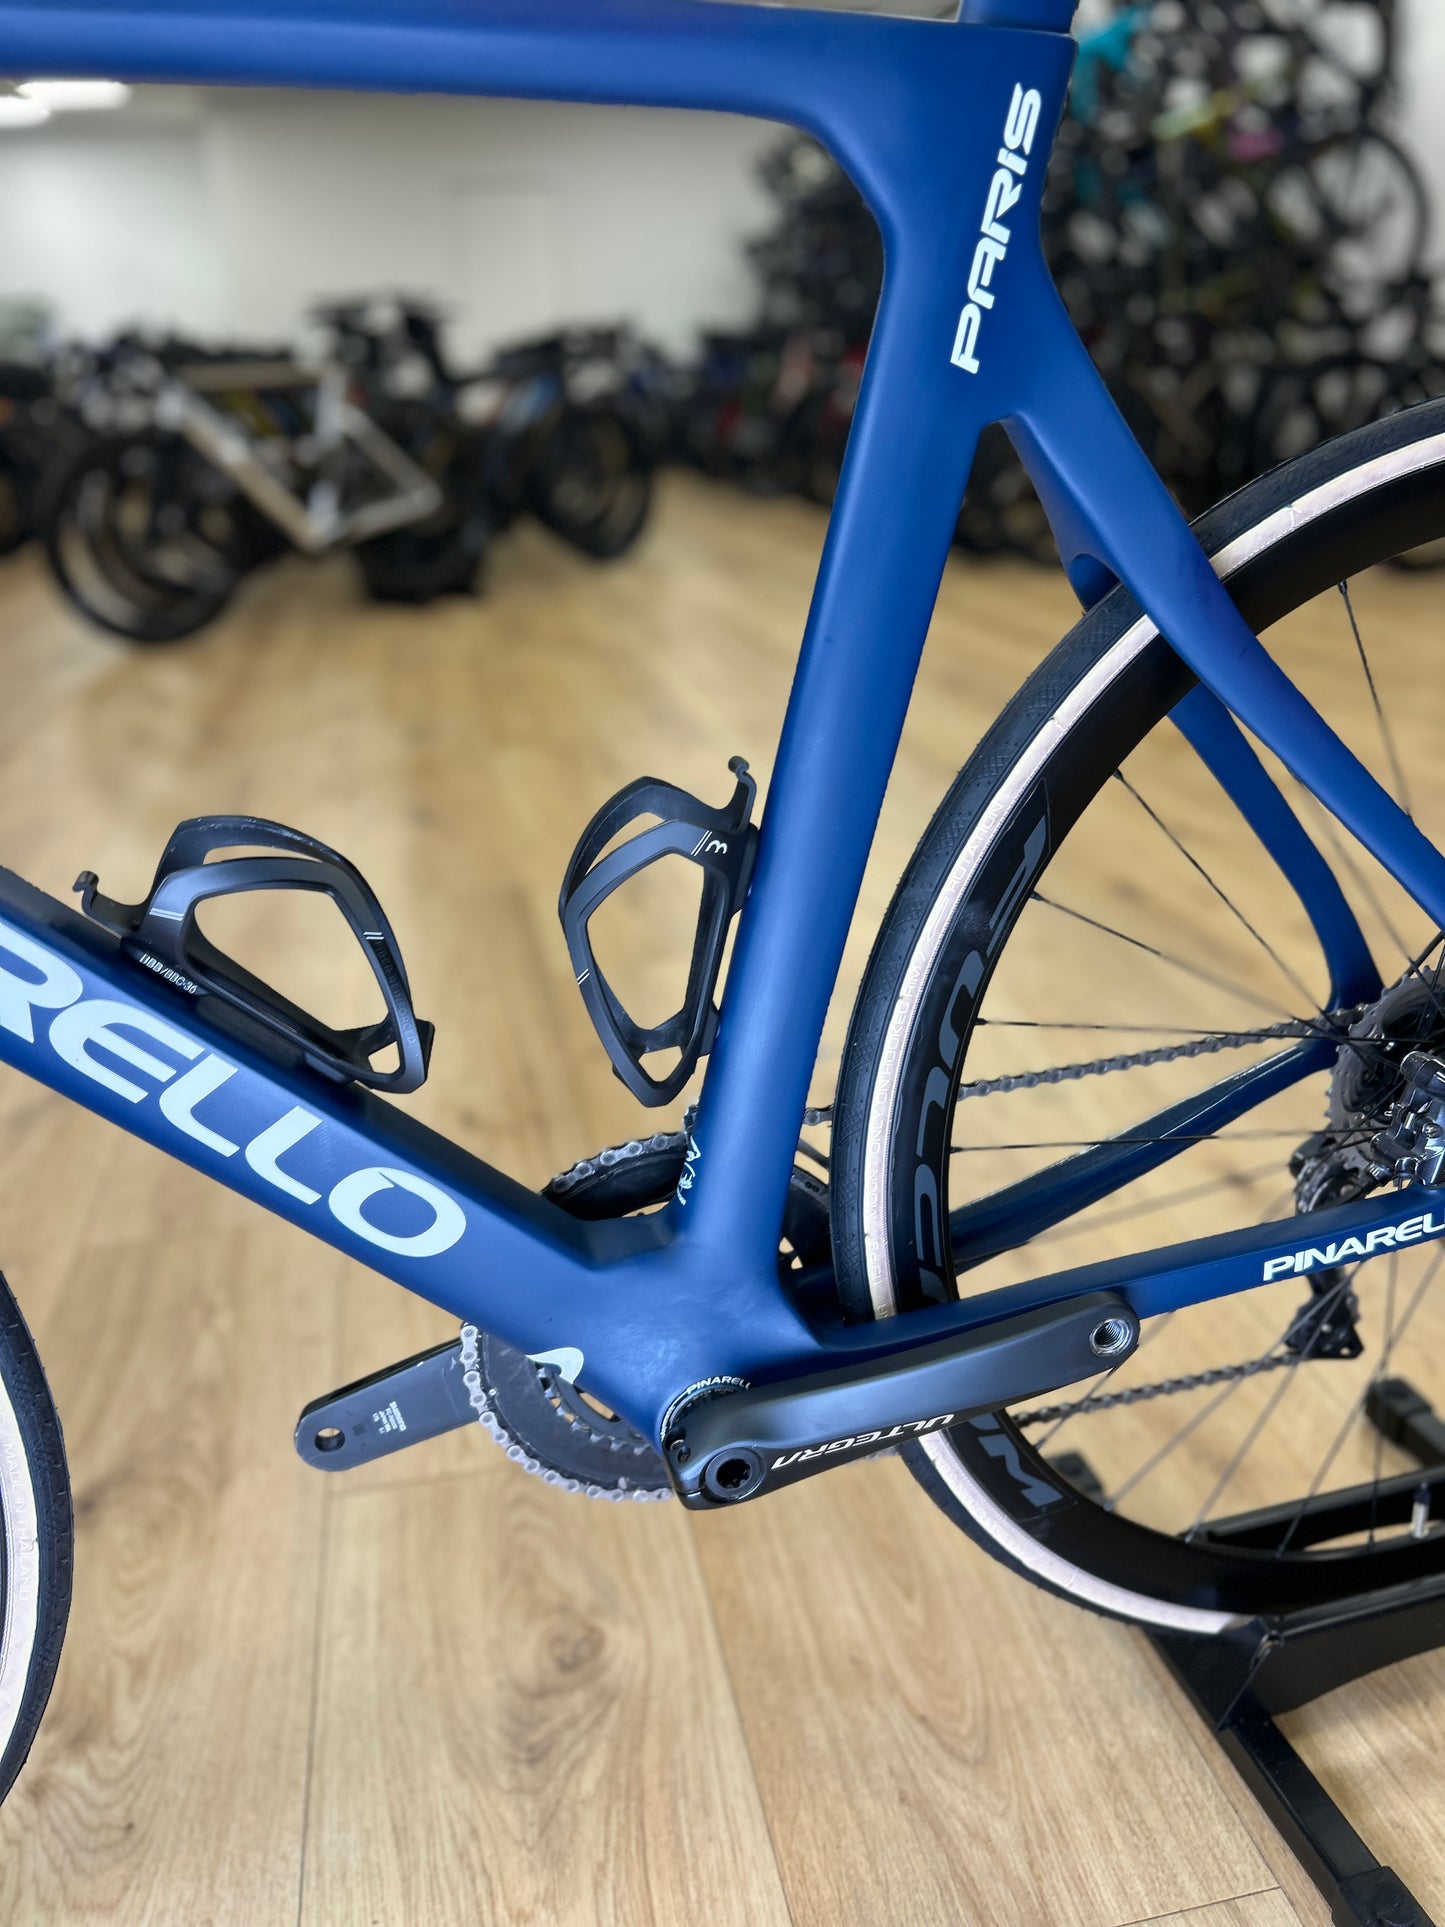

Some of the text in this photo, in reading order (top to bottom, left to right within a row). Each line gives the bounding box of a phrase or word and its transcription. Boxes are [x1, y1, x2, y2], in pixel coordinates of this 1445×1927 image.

[950, 82, 1042, 375] PARIS
[945, 799, 1004, 894] ROTATION
[904, 964, 923, 997] RIM
[882, 1002, 909, 1074] HOOKED
[0, 922, 467, 1258] RELLO
[876, 1078, 890, 1104] ON
[869, 1110, 884, 1153] ONLY
[771, 1413, 954, 1470] ULTEGRA
[14, 1496, 26, 1514] IN
